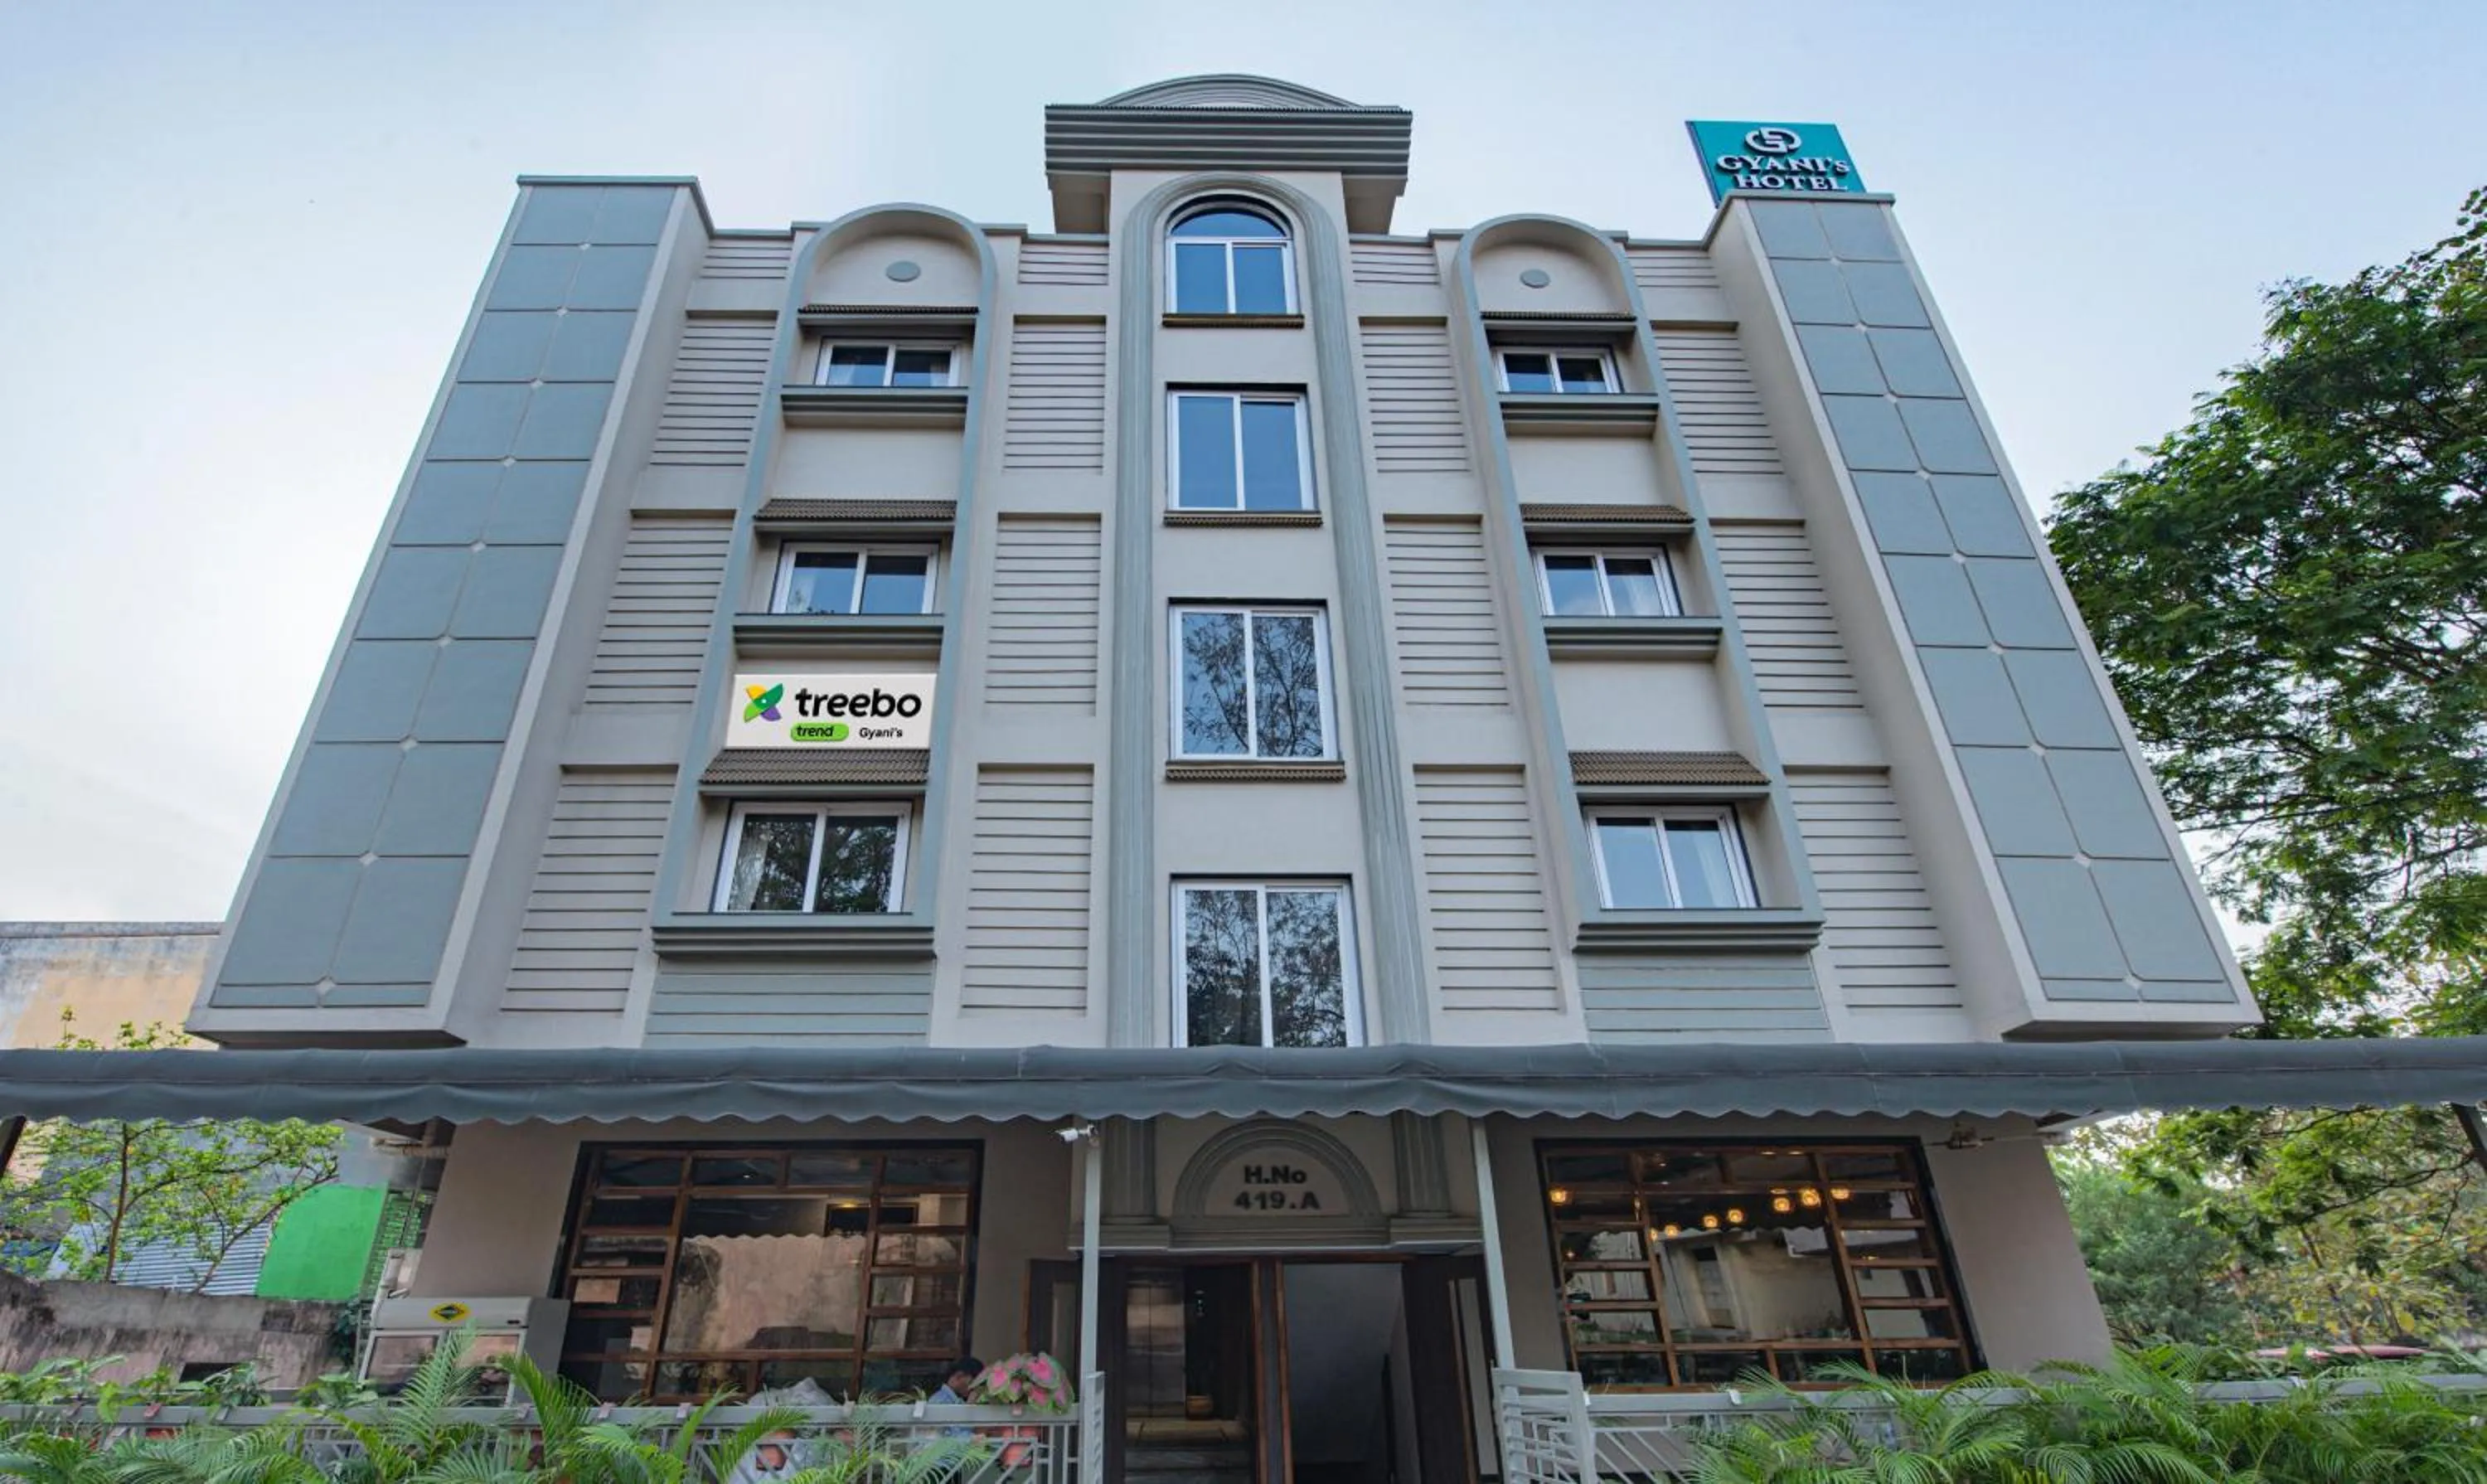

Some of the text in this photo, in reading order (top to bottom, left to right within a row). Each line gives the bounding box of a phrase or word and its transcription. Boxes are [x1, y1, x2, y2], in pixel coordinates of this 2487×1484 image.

[1734, 173, 1848, 192] HOTEL
[795, 688, 922, 717] treebo
[797, 725, 903, 740] trend Gyani's
[1244, 1165, 1307, 1184] H.No
[1234, 1191, 1321, 1210] 419.A
